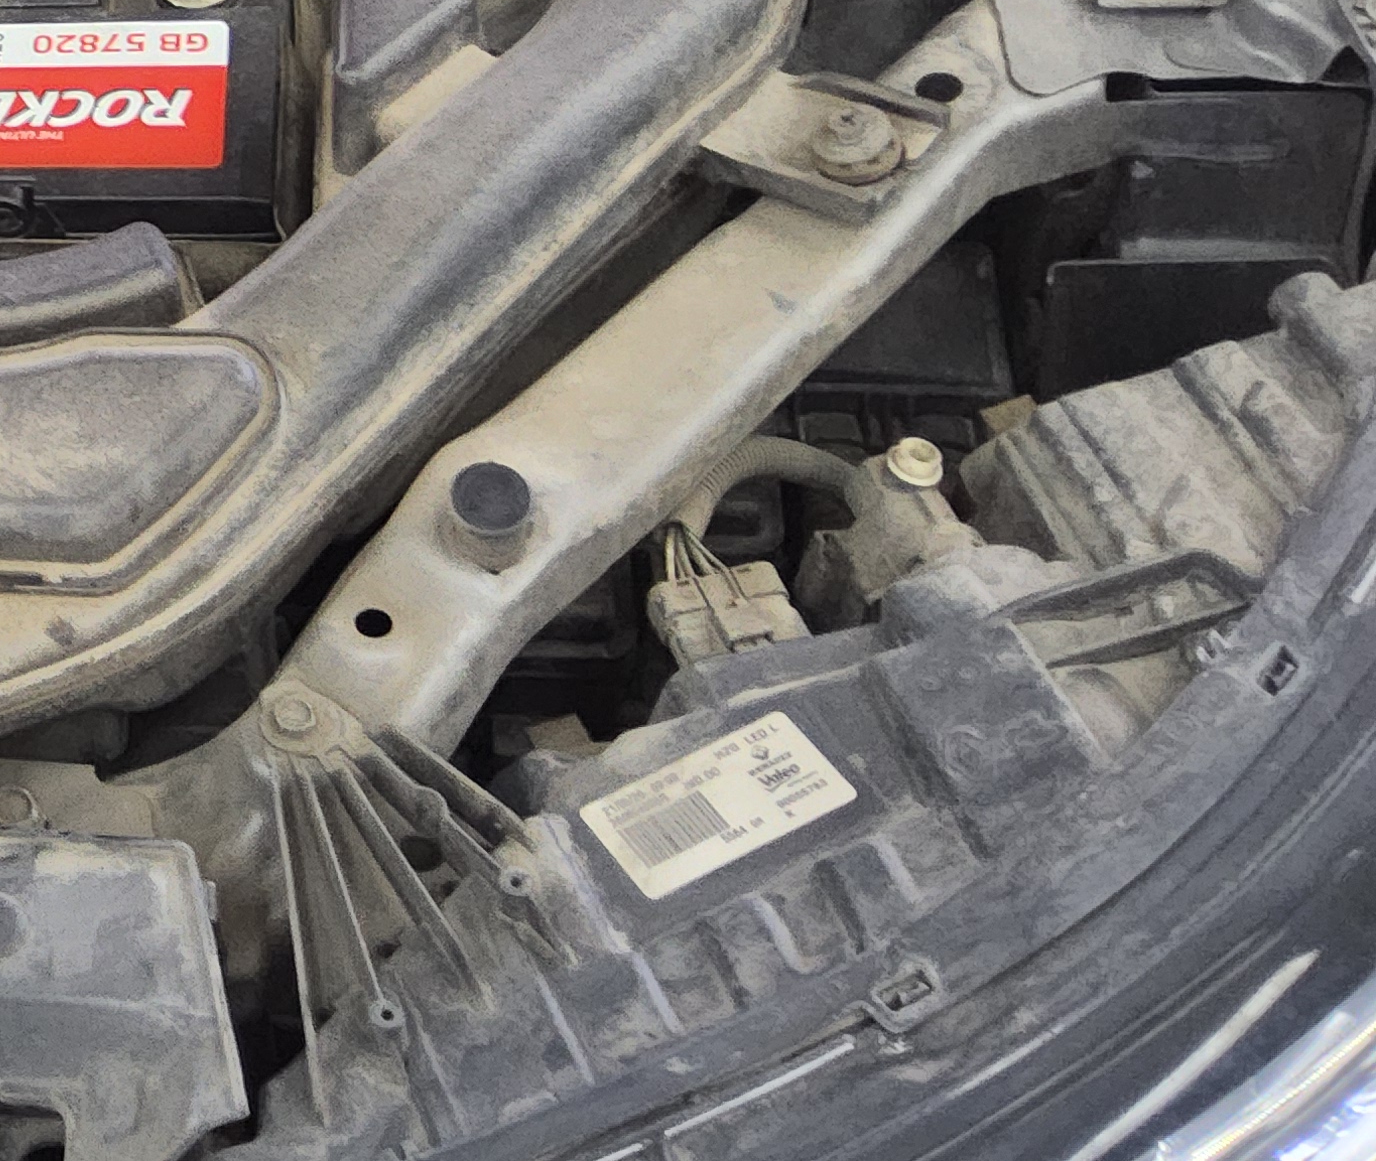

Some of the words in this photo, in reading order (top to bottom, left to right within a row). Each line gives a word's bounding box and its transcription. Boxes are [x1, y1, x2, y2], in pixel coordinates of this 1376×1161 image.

[33, 33, 147, 54] 57820
[159, 33, 209, 53] GB
[743, 727, 768, 745] LED
[757, 763, 800, 787] Valeo
